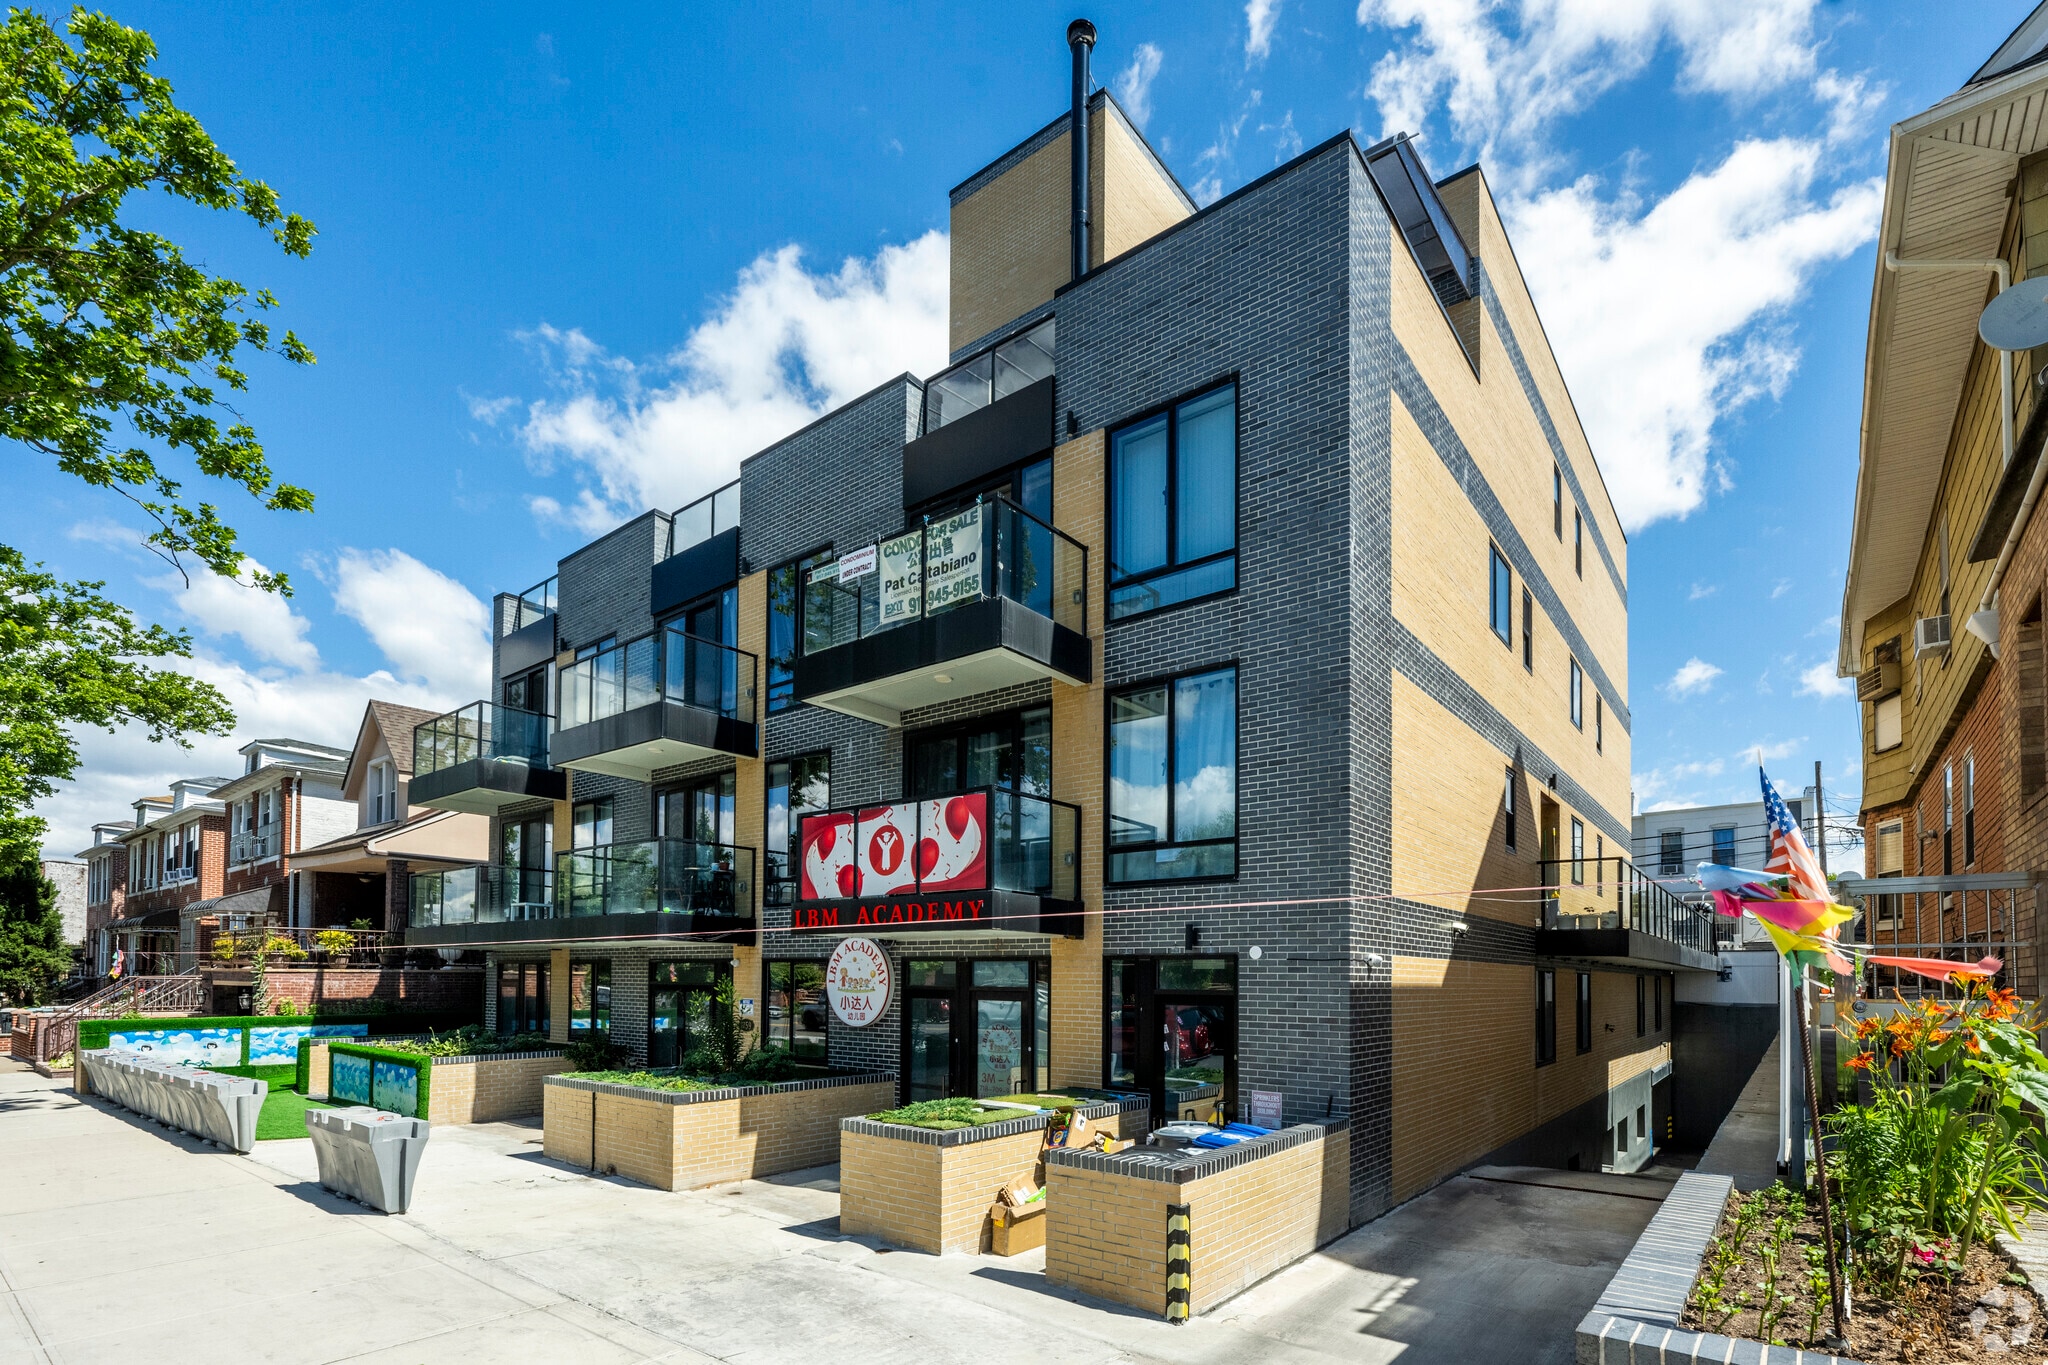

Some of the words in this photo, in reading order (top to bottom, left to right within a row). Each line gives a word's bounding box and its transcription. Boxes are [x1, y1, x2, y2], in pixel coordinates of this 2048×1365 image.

[949, 507, 979, 533] SALE
[841, 549, 875, 566] CONDOMINIUM
[907, 536, 954, 569] 公出售
[842, 568, 854, 579] UNDER
[854, 562, 873, 575] CONTRACT
[885, 576, 905, 593] Pat
[885, 600, 904, 615] EXIT
[908, 574, 980, 614] 91-945-9155
[794, 908, 838, 929] LBM
[857, 900, 984, 925] ACADEMY
[829, 952, 843, 984] LBM
[844, 940, 887, 986] ACADEMY
[840, 996, 873, 1011] 小达人
